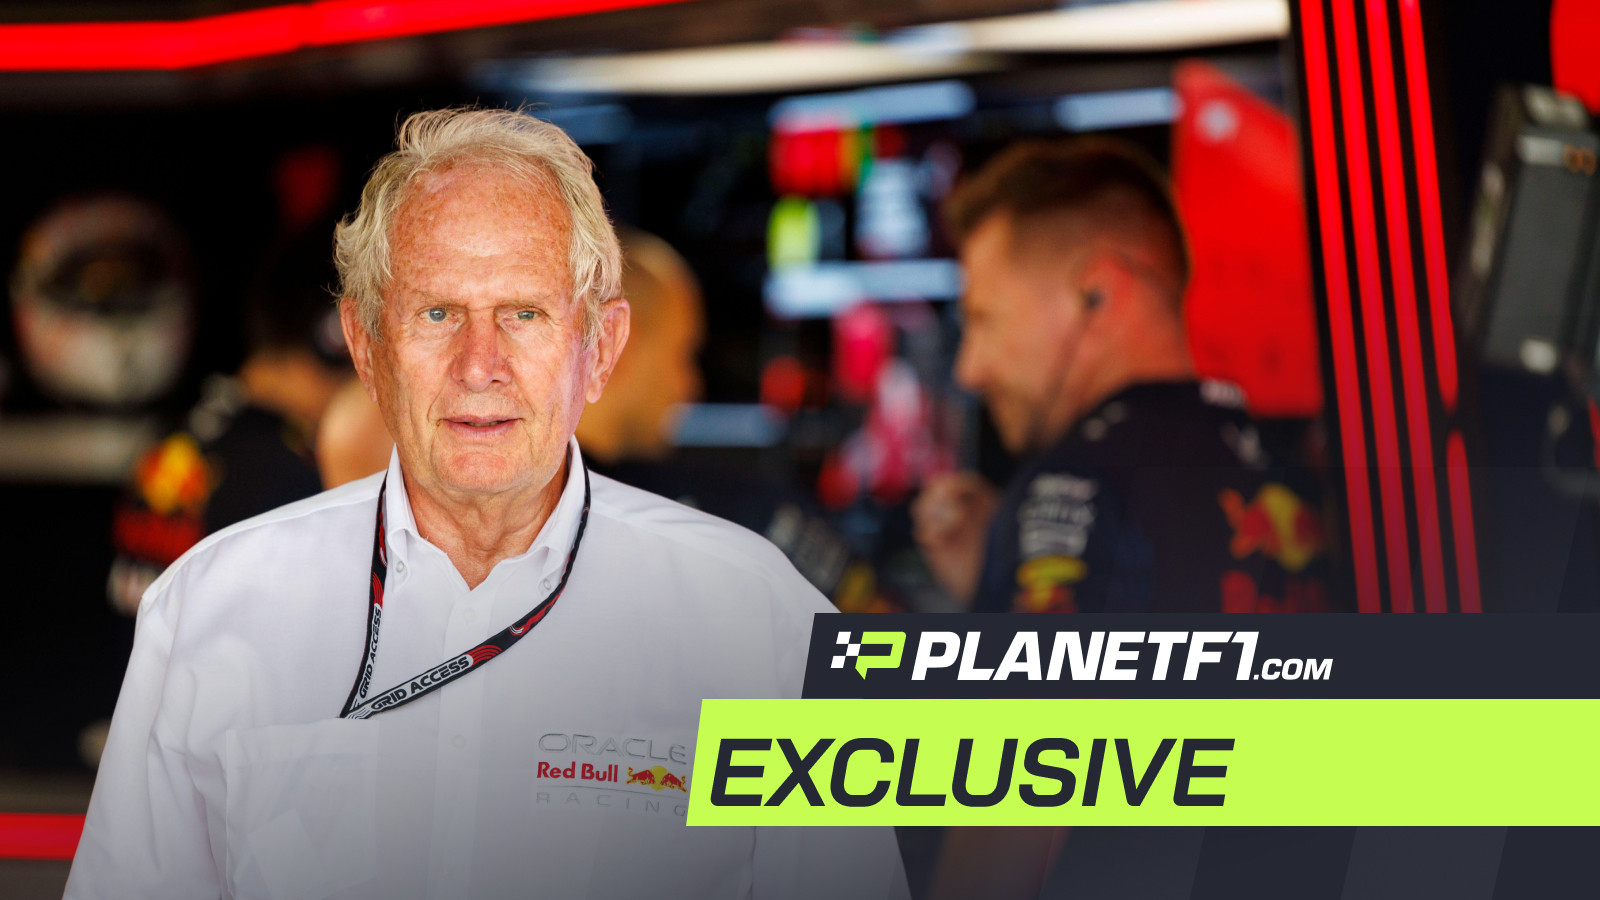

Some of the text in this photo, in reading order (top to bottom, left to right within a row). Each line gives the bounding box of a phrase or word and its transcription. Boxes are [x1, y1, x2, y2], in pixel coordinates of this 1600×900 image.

[359, 607, 382, 699] GRID ACCESS
[371, 656, 470, 711] GRID ACCESS
[538, 733, 687, 766] ORACLE
[537, 761, 619, 783] Red Bull
